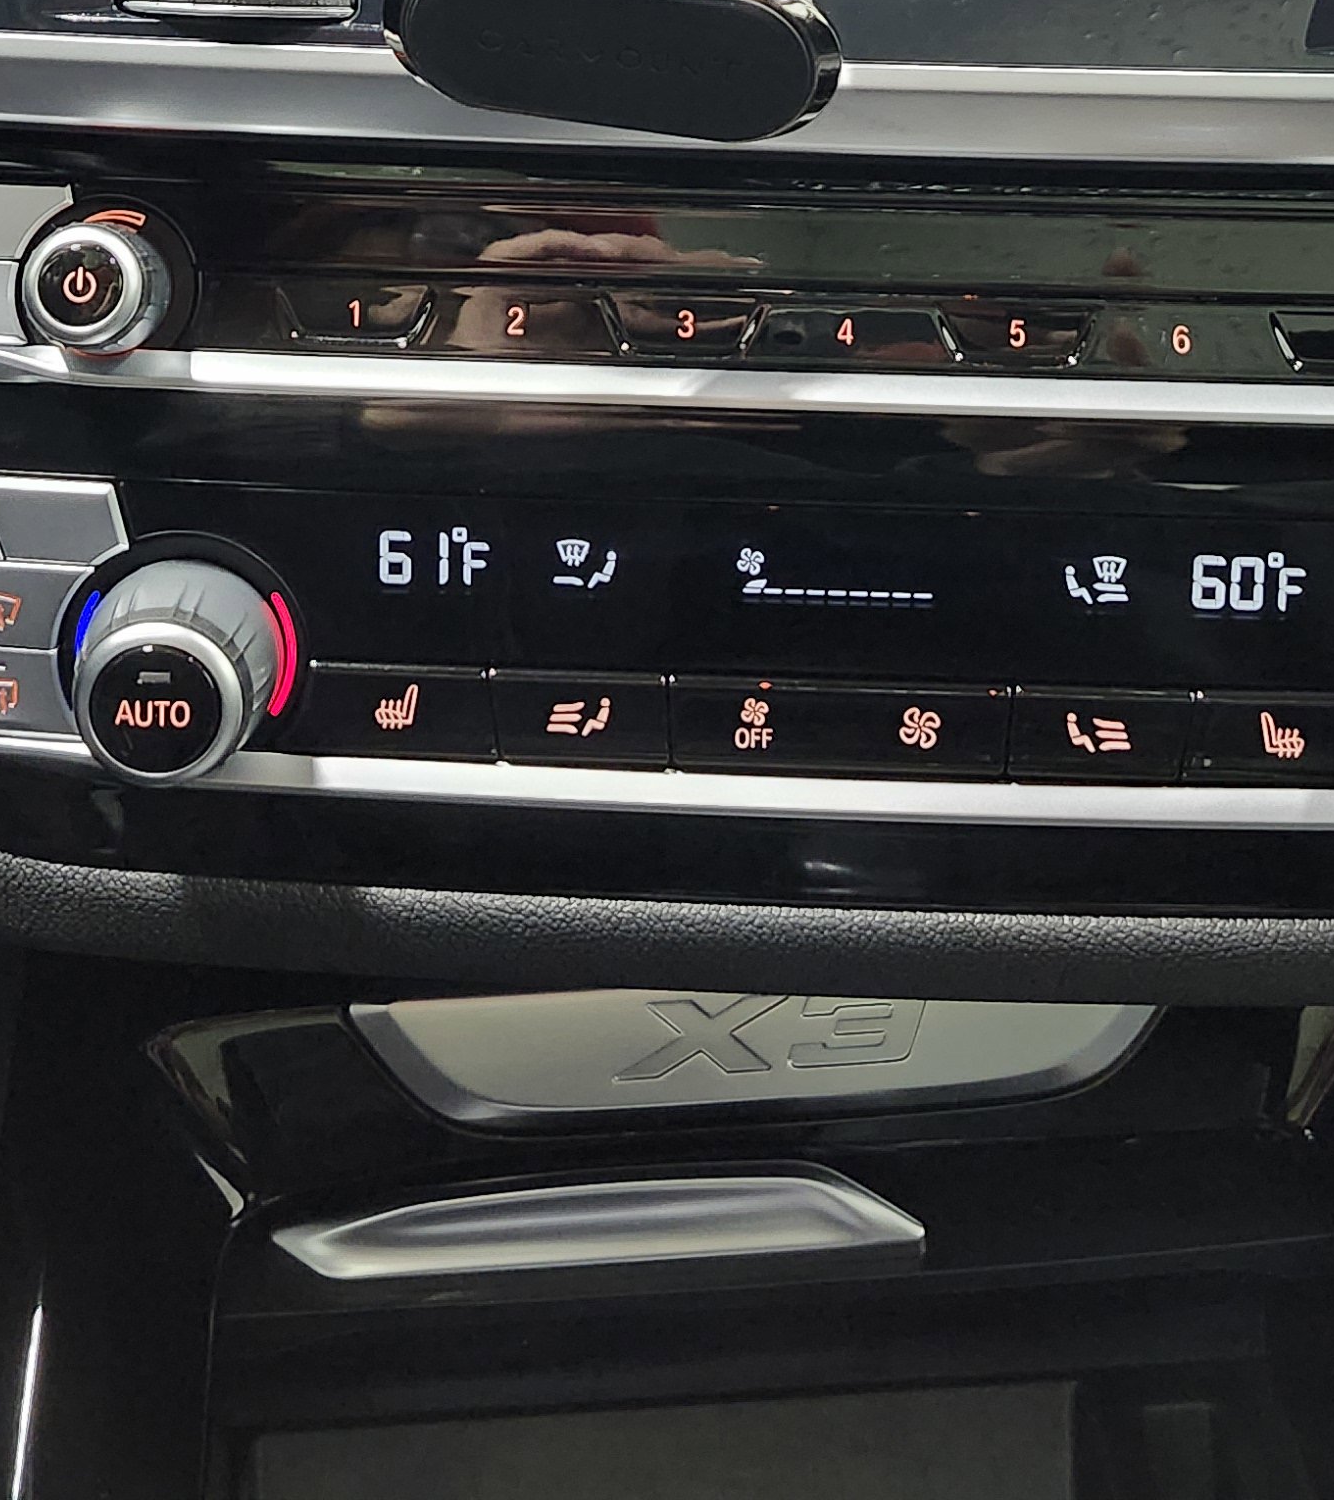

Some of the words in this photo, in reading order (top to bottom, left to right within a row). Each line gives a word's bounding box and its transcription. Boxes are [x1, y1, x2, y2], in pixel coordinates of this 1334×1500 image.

[348, 300, 362, 327] 1
[507, 306, 525, 336] 2
[677, 310, 695, 339] 3
[836, 318, 854, 346] 4
[1009, 319, 1027, 348] 5
[1172, 325, 1192, 354] 6
[1190, 552, 1308, 613] 60°F
[114, 699, 191, 729] AUTO
[734, 728, 773, 750] OFF
[612, 994, 928, 1082] X3
